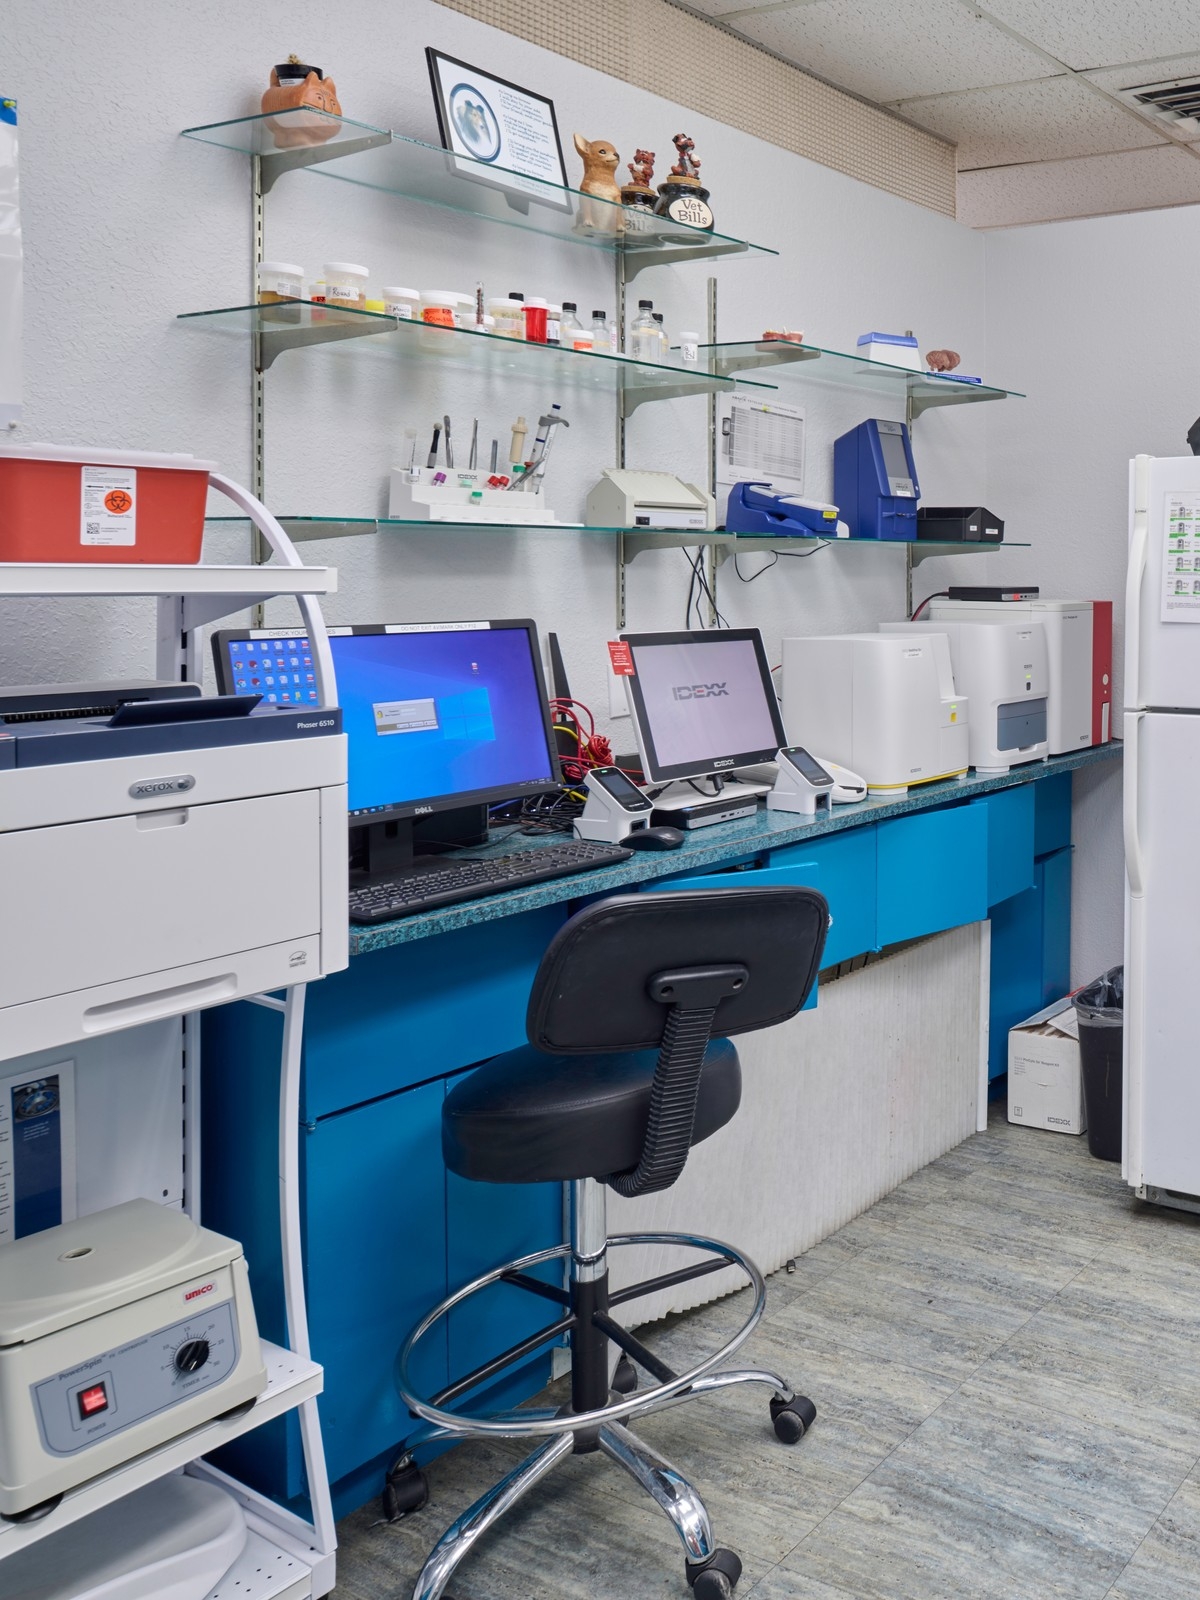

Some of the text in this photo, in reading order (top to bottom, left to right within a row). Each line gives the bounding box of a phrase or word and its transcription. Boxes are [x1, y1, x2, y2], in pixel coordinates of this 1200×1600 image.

[681, 199, 704, 212] Vet
[677, 210, 708, 225] Bills
[268, 630, 289, 638] CHECK
[672, 682, 730, 701] IDEXX
[297, 719, 335, 729] Phaser 6510
[714, 758, 735, 768] IDEXX
[136, 780, 173, 794] xerox
[415, 806, 433, 815] DELL
[87, 1422, 107, 1434] POWER
